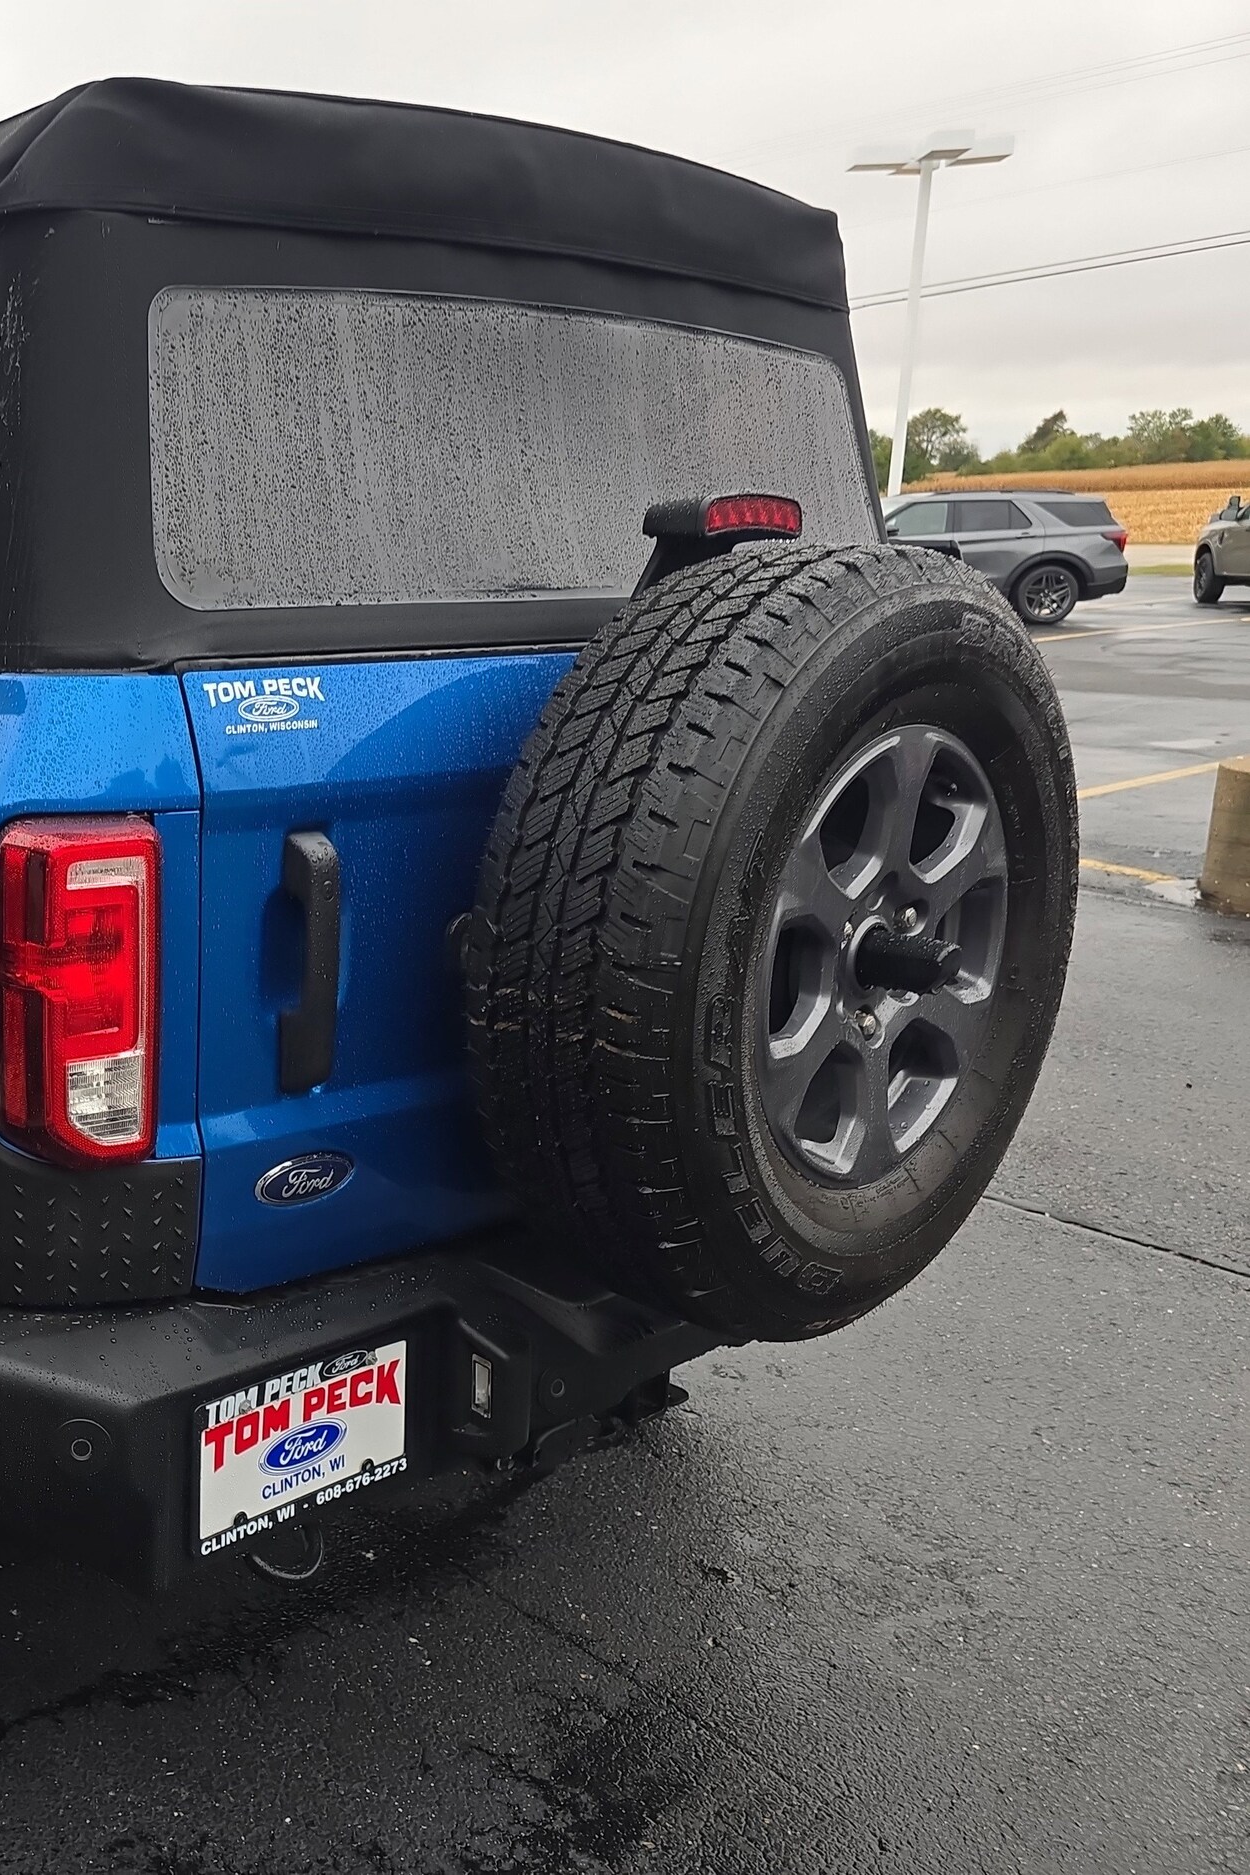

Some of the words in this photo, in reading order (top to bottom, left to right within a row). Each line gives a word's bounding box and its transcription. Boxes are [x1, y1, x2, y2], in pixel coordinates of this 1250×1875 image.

[203, 681, 256, 708] TOM
[263, 676, 326, 702] PECK
[226, 722, 268, 735] CLINTON,
[270, 719, 318, 731] WISCONSIN
[282, 1165, 334, 1198] Ford
[204, 1398, 291, 1474] TOM
[303, 1359, 402, 1423] PECK
[206, 1386, 259, 1427] TOM
[264, 1361, 324, 1403] PECK
[262, 1464, 326, 1500] CLINTON,
[329, 1454, 346, 1474] WI
[200, 1516, 274, 1556] CLINTON,
[276, 1503, 296, 1523] WI
[315, 1457, 408, 1506] 608-676-2273
